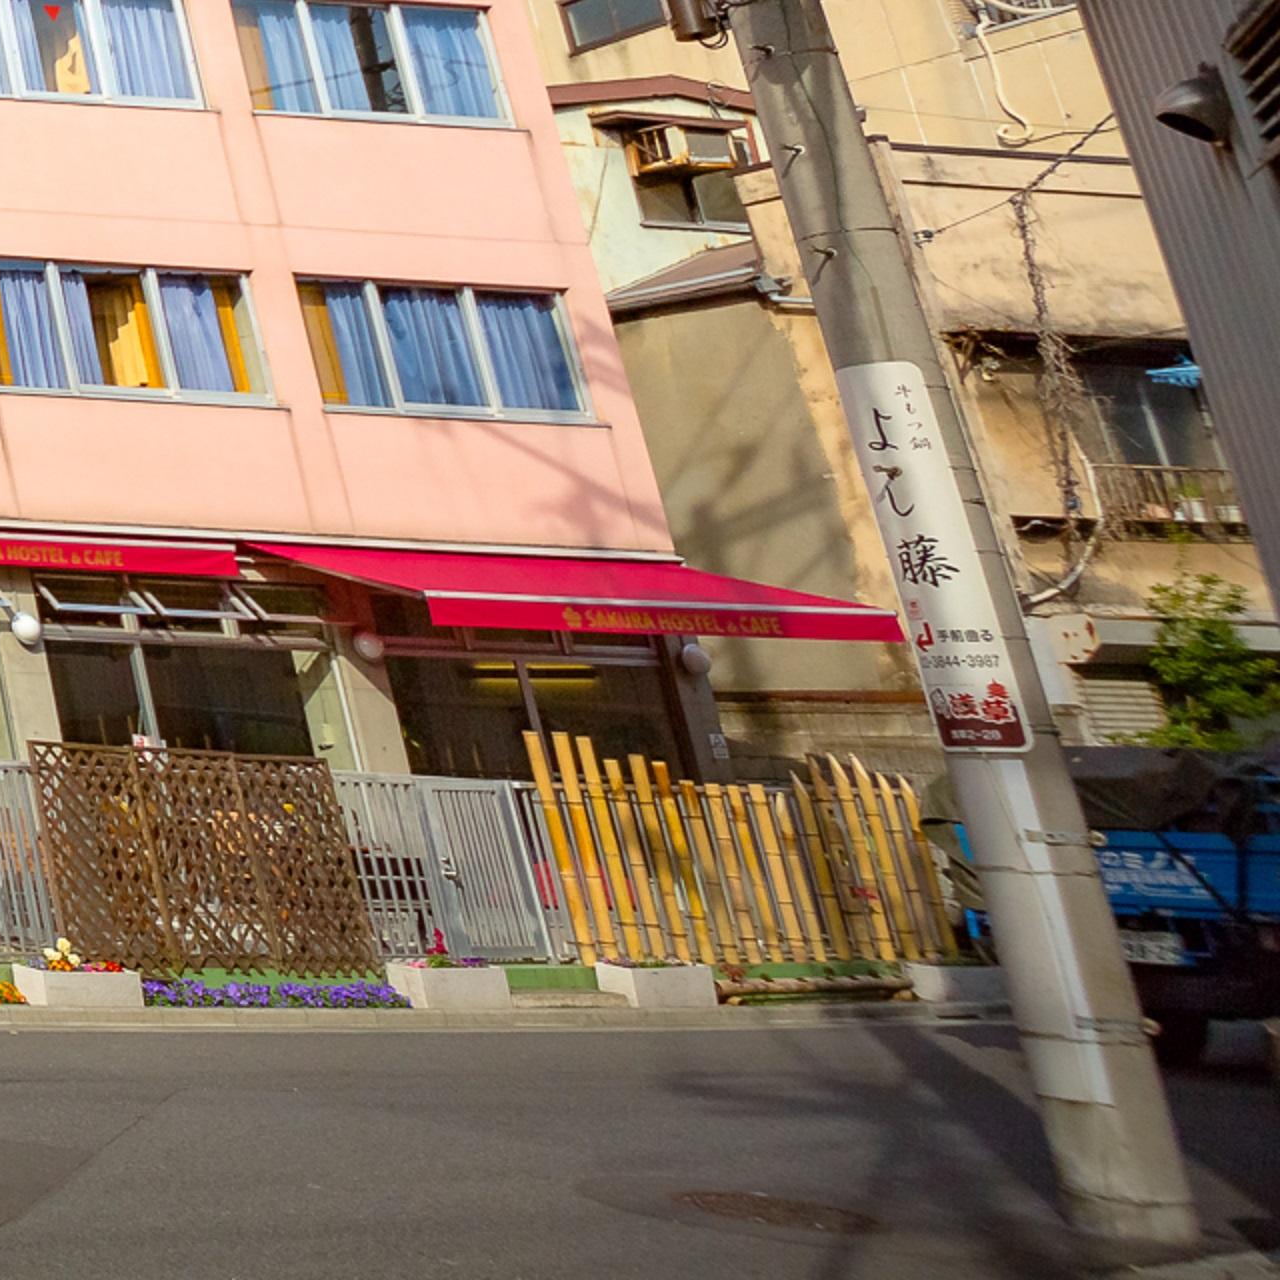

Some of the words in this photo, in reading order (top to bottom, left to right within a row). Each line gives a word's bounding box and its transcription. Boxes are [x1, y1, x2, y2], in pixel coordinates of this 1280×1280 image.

[6, 545, 68, 564] HOSTEL
[71, 551, 81, 565] &
[83, 549, 125, 567] CAFE
[586, 609, 655, 629] SAKURA
[656, 612, 725, 633] HOSTEL
[739, 616, 784, 635] CAFE
